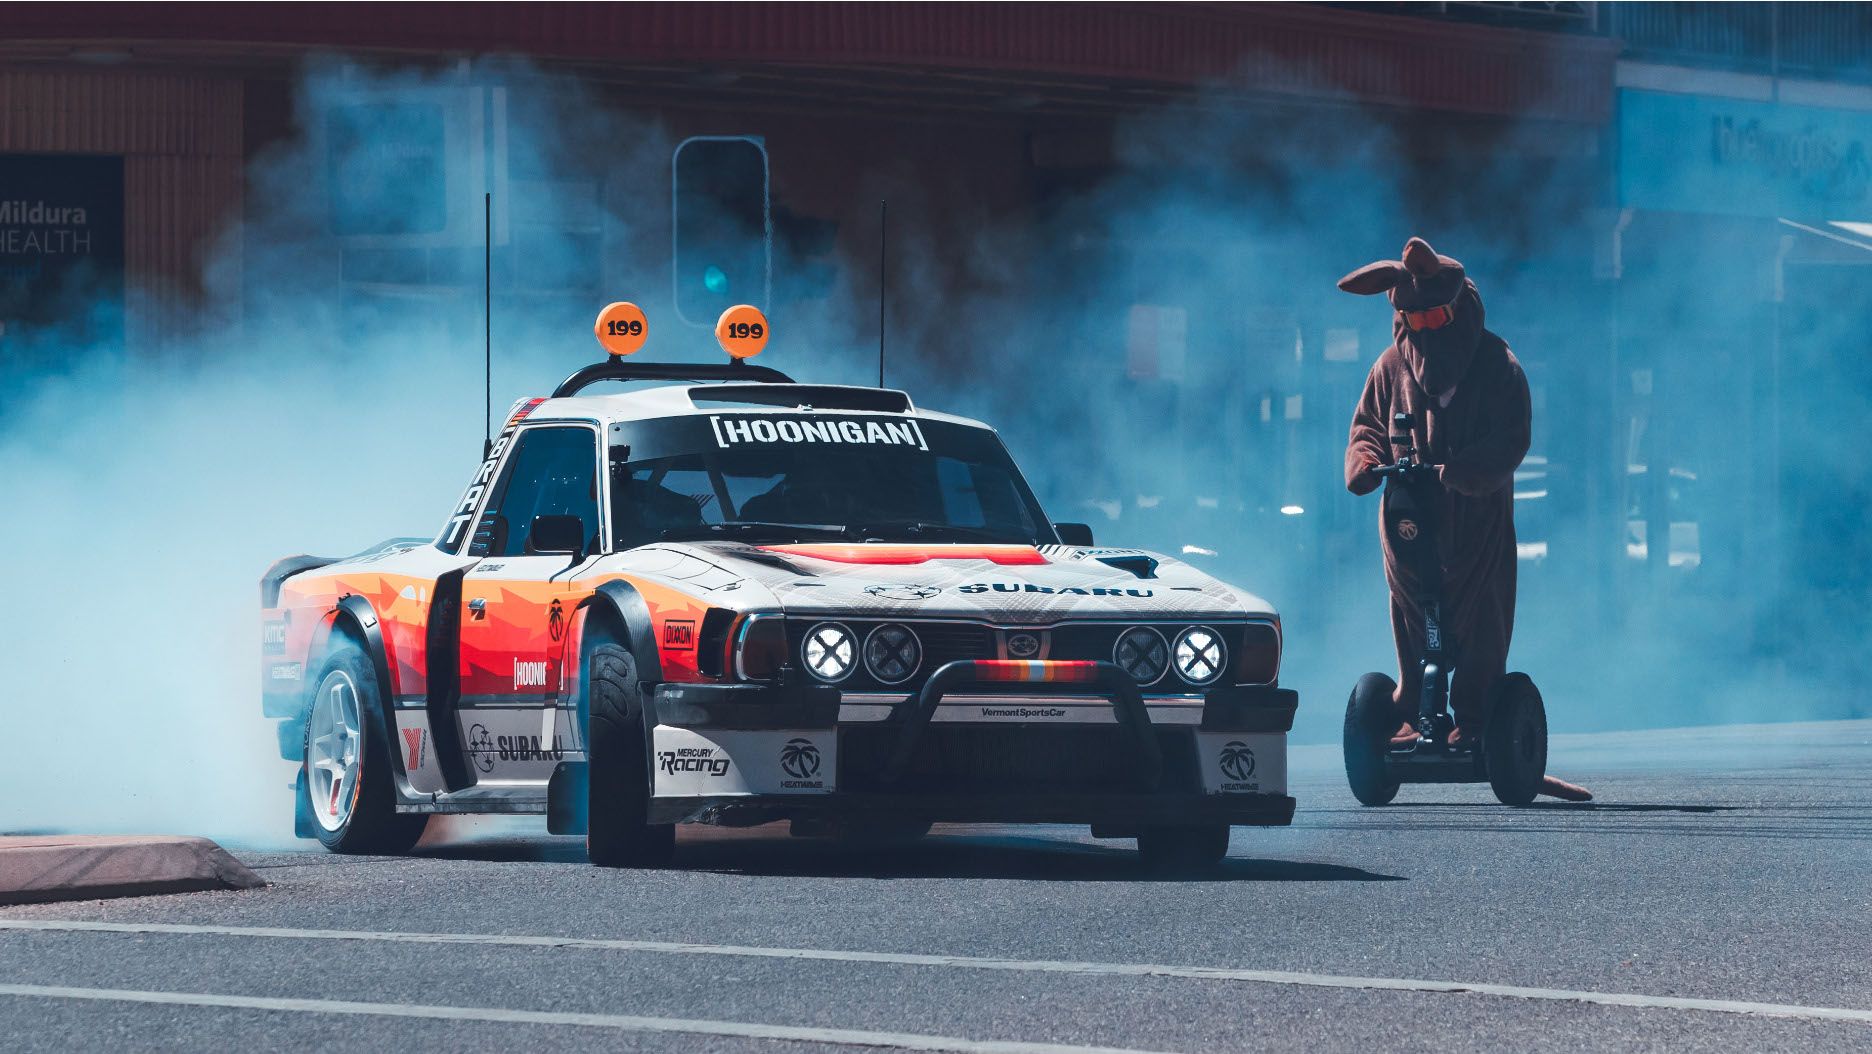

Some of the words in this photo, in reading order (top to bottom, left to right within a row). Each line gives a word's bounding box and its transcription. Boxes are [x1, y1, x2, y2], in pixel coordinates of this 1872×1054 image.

[607, 320, 642, 336] 199
[728, 322, 763, 339] 199
[710, 416, 929, 451] [HOONIGAN]
[446, 436, 510, 544] BRAT
[959, 583, 1154, 598] SUBARU
[677, 749, 713, 758] MERCURY
[660, 751, 730, 776] Racing
